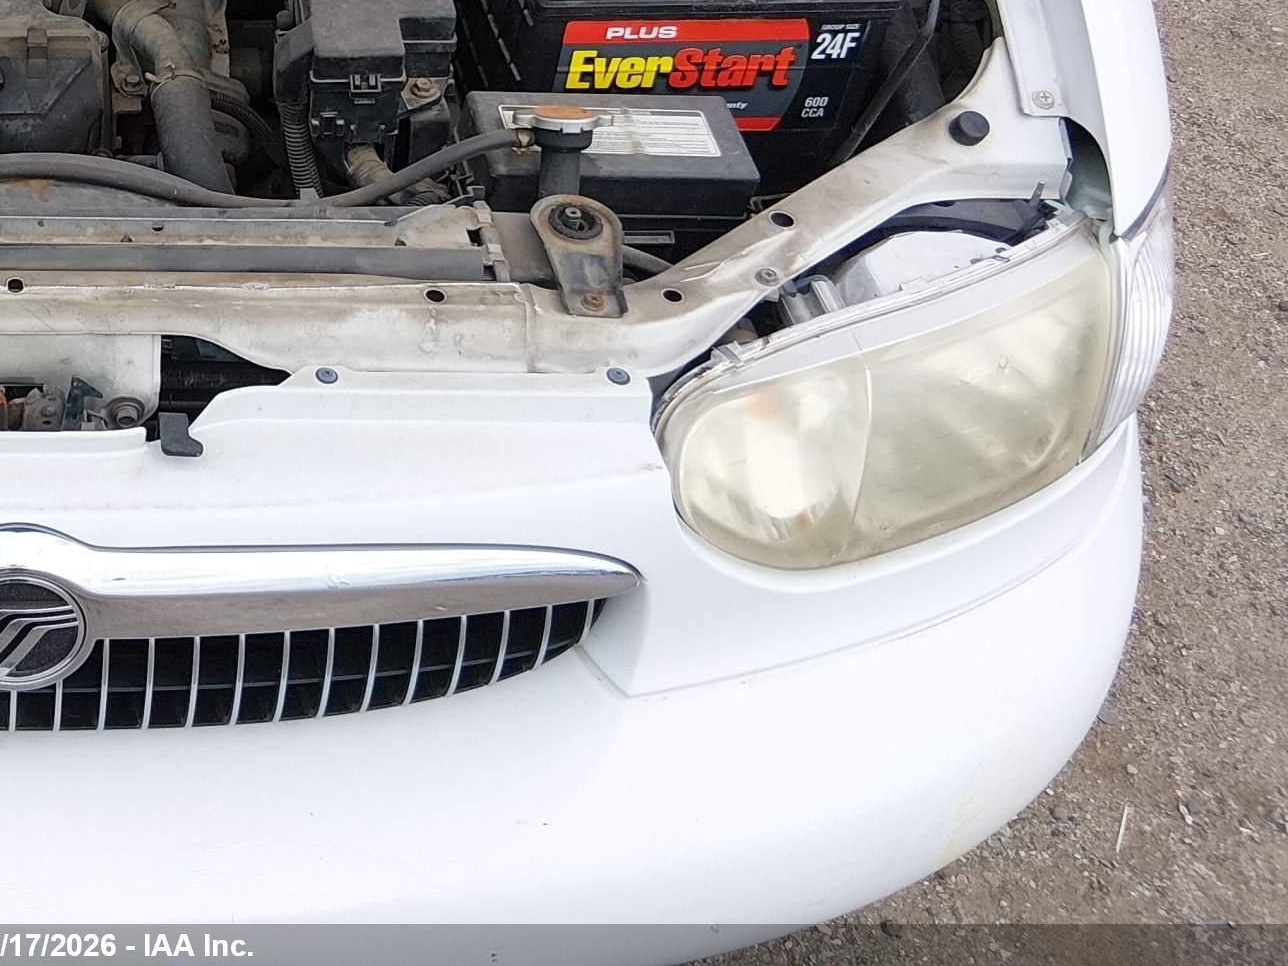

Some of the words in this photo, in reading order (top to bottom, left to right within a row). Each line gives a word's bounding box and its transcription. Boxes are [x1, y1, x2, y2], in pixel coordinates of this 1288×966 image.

[606, 26, 678, 40] PLUS
[821, 23, 845, 31] GROUP
[811, 32, 861, 60] 24F
[565, 47, 796, 89] EverStart
[804, 96, 829, 107] 600
[801, 107, 824, 118] CCA
